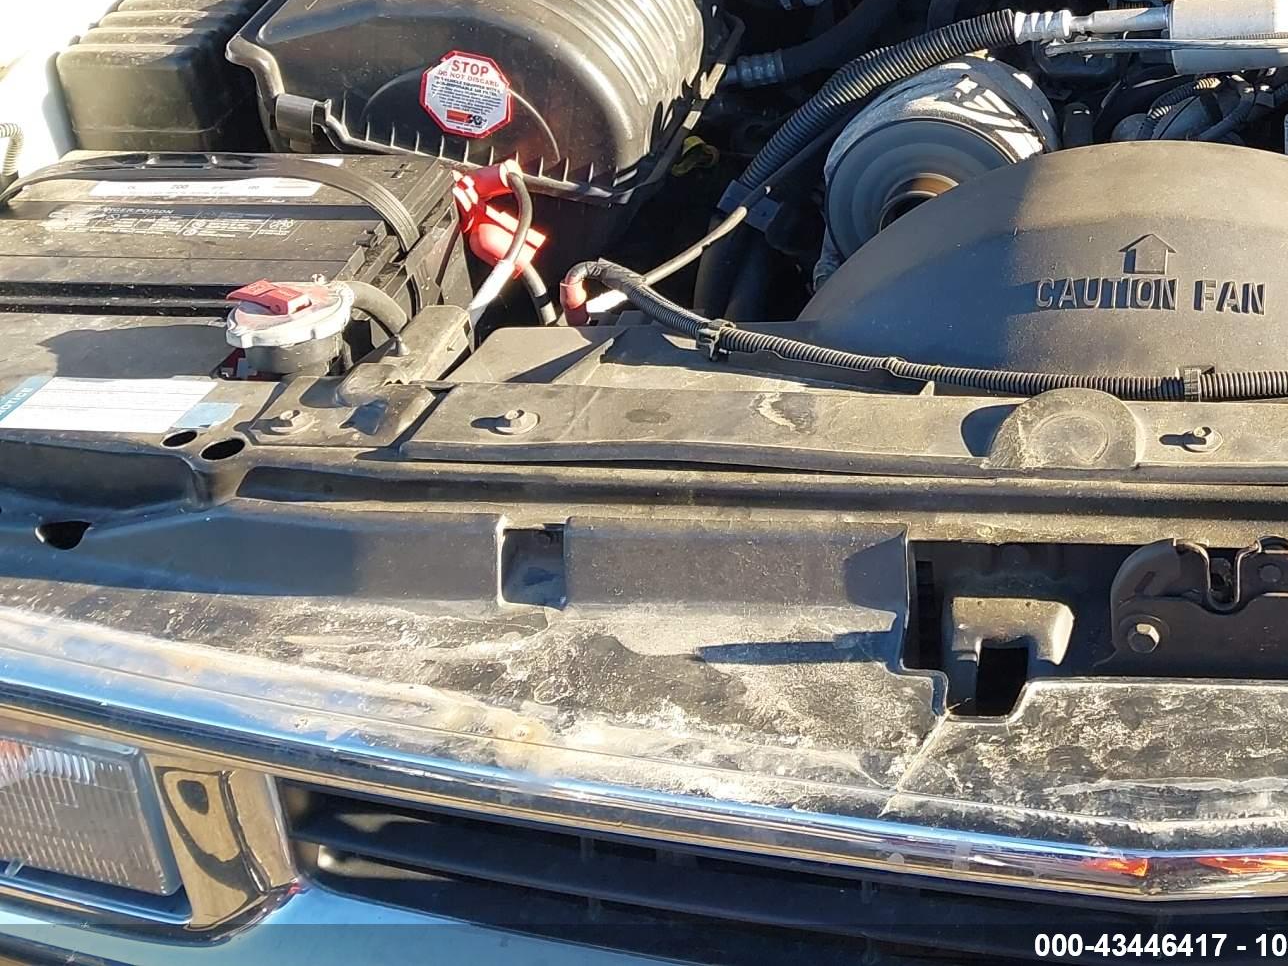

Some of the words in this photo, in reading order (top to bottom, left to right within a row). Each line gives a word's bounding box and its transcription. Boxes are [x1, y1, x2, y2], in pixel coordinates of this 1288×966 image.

[449, 72, 465, 80] NOT
[451, 60, 489, 76] STOP
[1034, 277, 1178, 312] CAUTION
[1194, 279, 1266, 316] FAN
